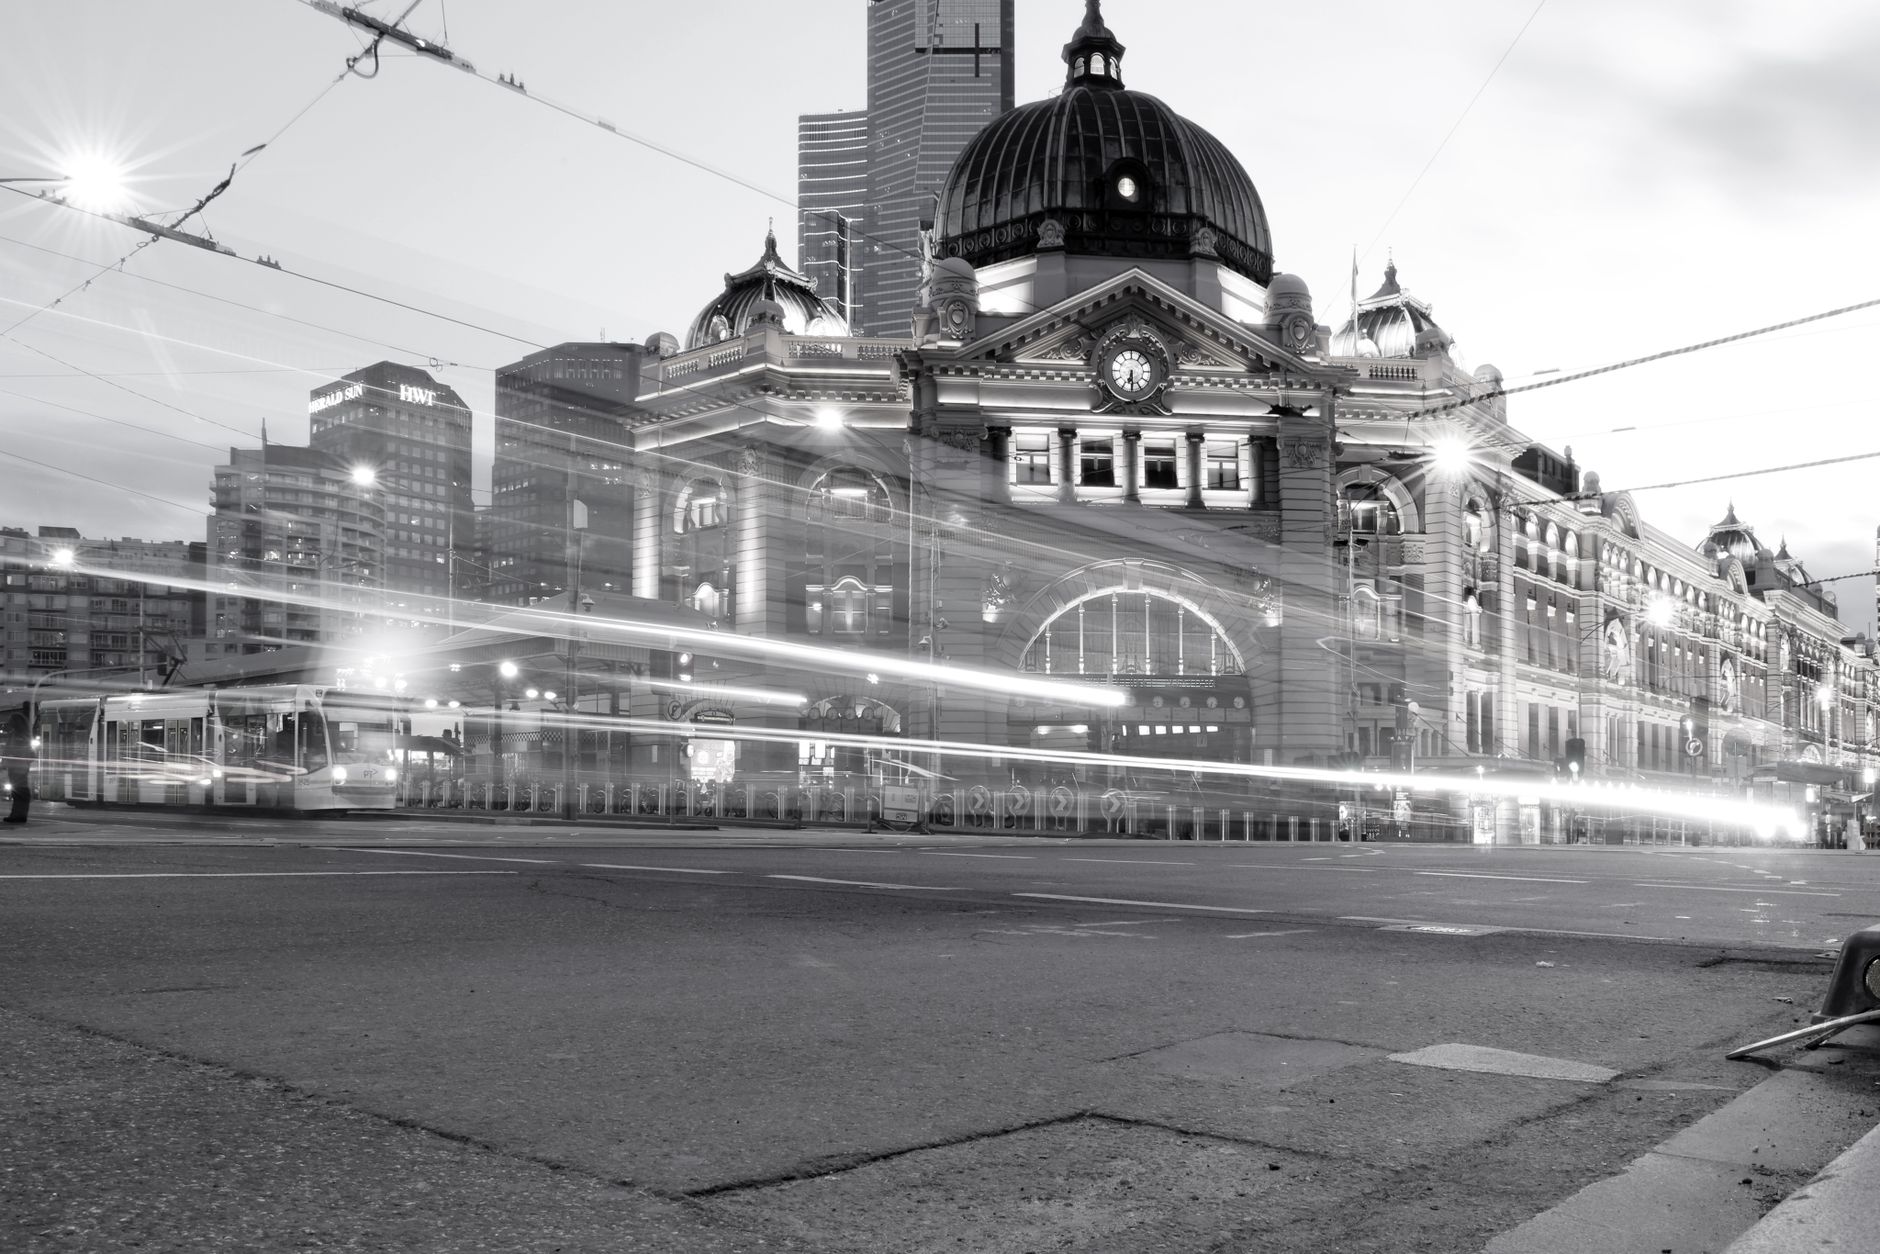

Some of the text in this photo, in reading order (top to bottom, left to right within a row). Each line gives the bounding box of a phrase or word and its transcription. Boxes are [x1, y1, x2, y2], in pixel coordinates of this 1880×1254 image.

[309, 384, 363, 413] HERALD SUN
[400, 384, 436, 406] HWT
